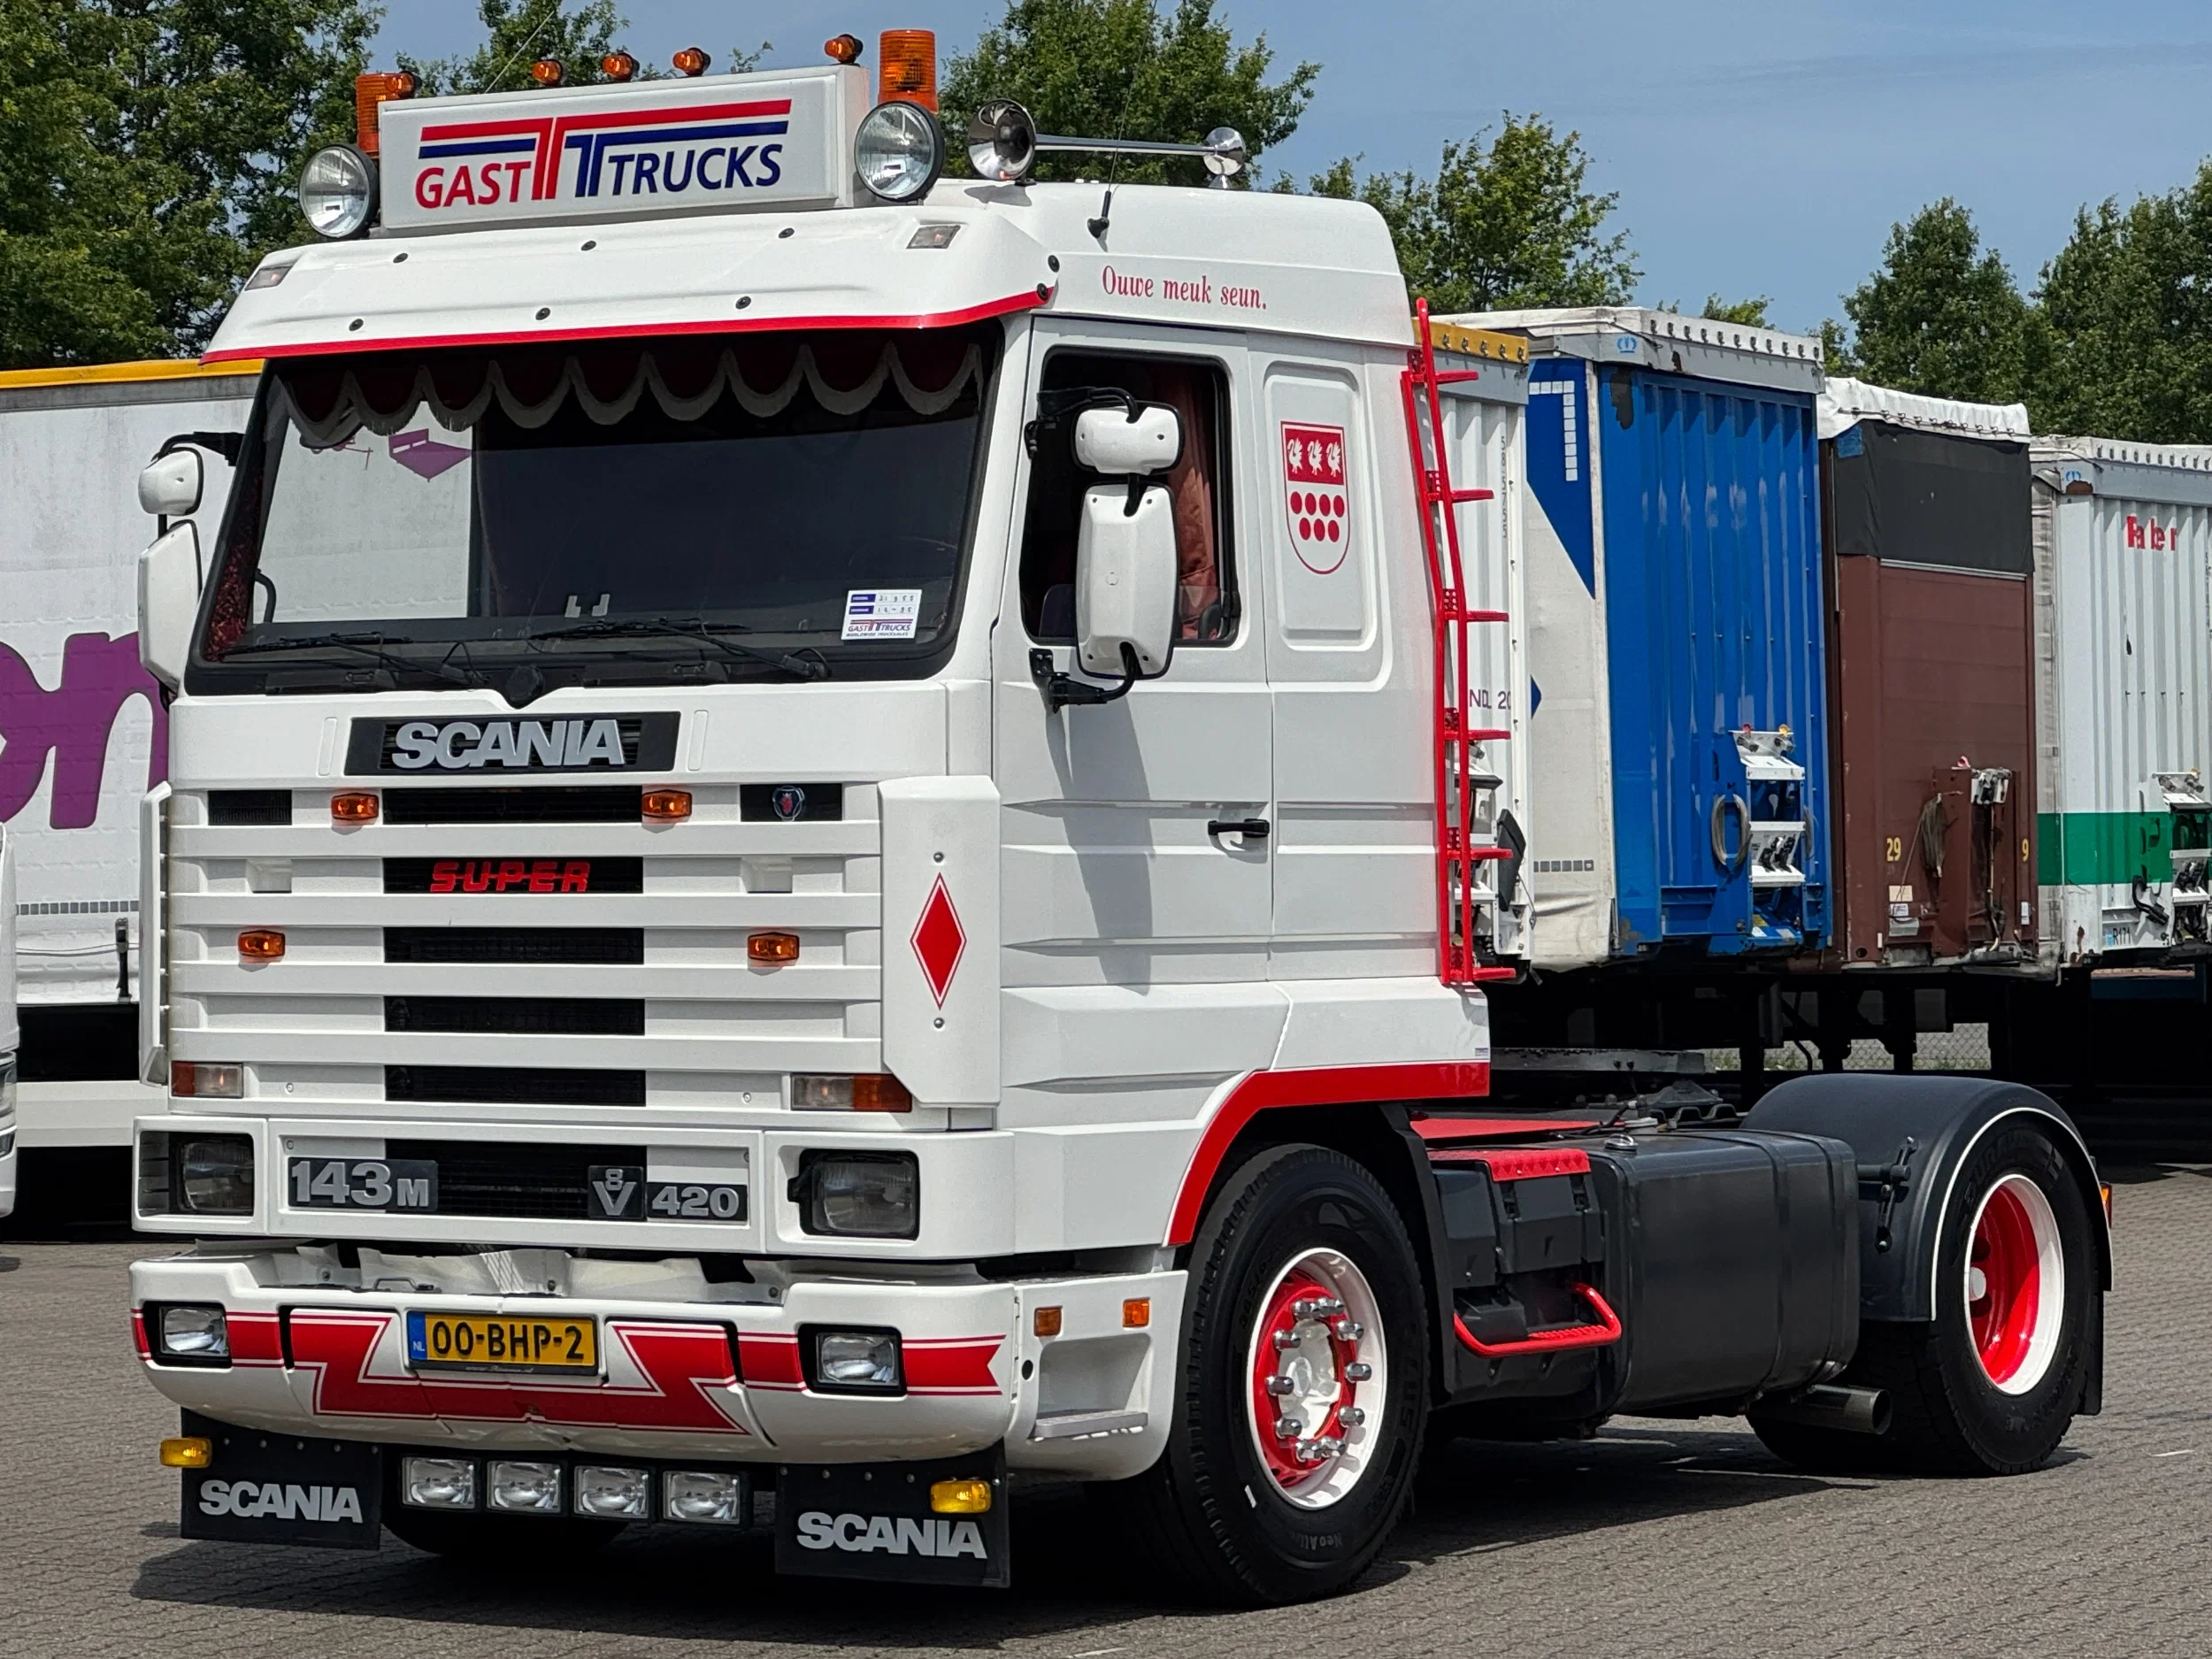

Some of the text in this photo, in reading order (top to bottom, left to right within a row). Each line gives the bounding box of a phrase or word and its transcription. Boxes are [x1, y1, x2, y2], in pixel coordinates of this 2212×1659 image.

[414, 161, 531, 209] GAST
[608, 143, 783, 196] TRUCKS
[1102, 265, 1267, 310] Ouwe meuk seun.
[391, 718, 626, 769] SCANIA
[1886, 837, 1901, 862] 29
[2022, 838, 2030, 863] 9
[430, 861, 591, 893] SUPER
[651, 1186, 740, 1217] 420
[412, 1341, 426, 1352] NL
[432, 1320, 584, 1359] 00-BHP-2
[199, 1479, 364, 1524] SCANIA
[796, 1511, 988, 1559] SCANIA
